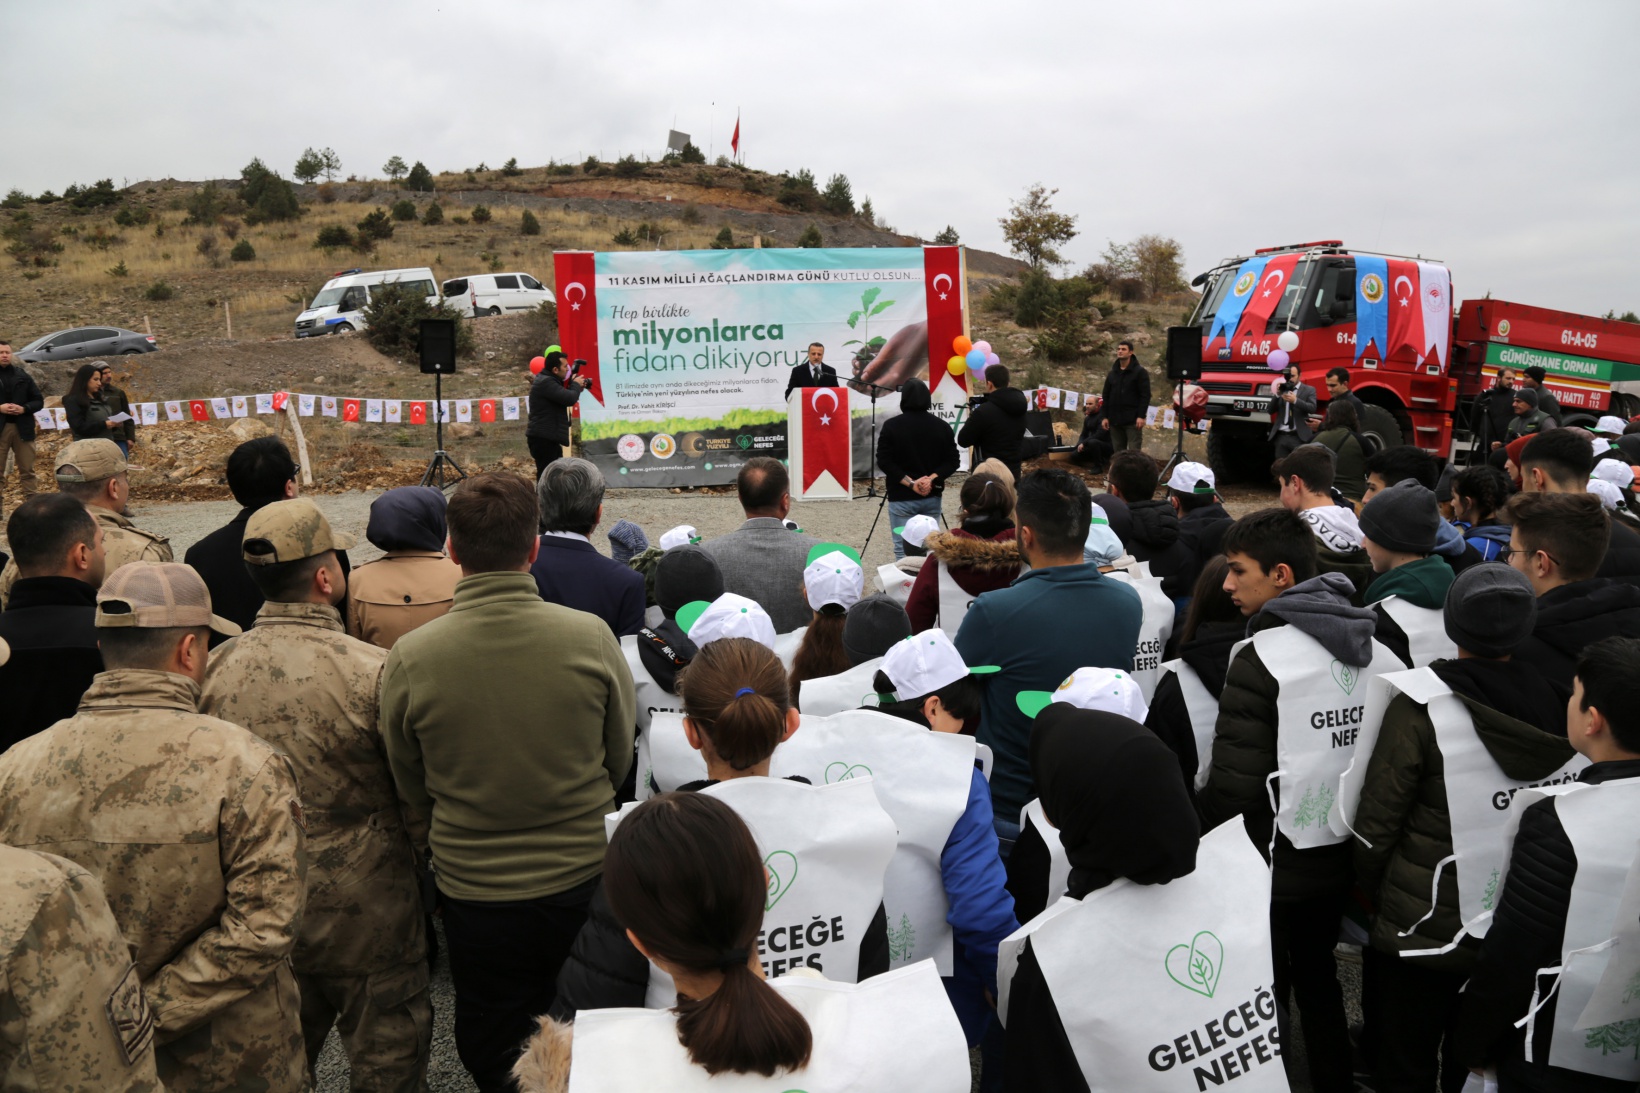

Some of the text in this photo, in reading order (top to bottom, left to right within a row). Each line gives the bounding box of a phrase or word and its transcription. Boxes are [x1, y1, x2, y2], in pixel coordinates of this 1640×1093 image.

[608, 278, 618, 286] 11
[623, 276, 660, 285] KASIM
[664, 273, 696, 284] MİLLİ
[700, 272, 794, 285] AĞAÇLANDIRMA
[797, 270, 830, 281] GÜNÜ
[834, 272, 870, 281] KUTLU
[610, 303, 691, 322] Hep birlikte
[613, 318, 784, 350] milyonlarca
[1561, 330, 1598, 348] 61-A-05
[1260, 340, 1271, 355] 05
[613, 345, 809, 374] fidan dikiyoruz
[1500, 348, 1598, 374] GÜMÜŞHANE ORMAN
[670, 389, 699, 397] yüzyılına
[1563, 392, 1584, 405] HATTI
[1590, 392, 1601, 400] ALO
[1589, 401, 1600, 409] 112
[640, 628, 656, 638] NIKE
[662, 645, 676, 660] NIKE
[1136, 638, 1161, 654] ECEĞ
[1311, 705, 1364, 730] GELECE
[1332, 727, 1359, 749] NEF
[758, 915, 844, 955] ECEĞE
[1148, 985, 1275, 1072] GELECEĞ
[1193, 1026, 1281, 1092] NEFES
